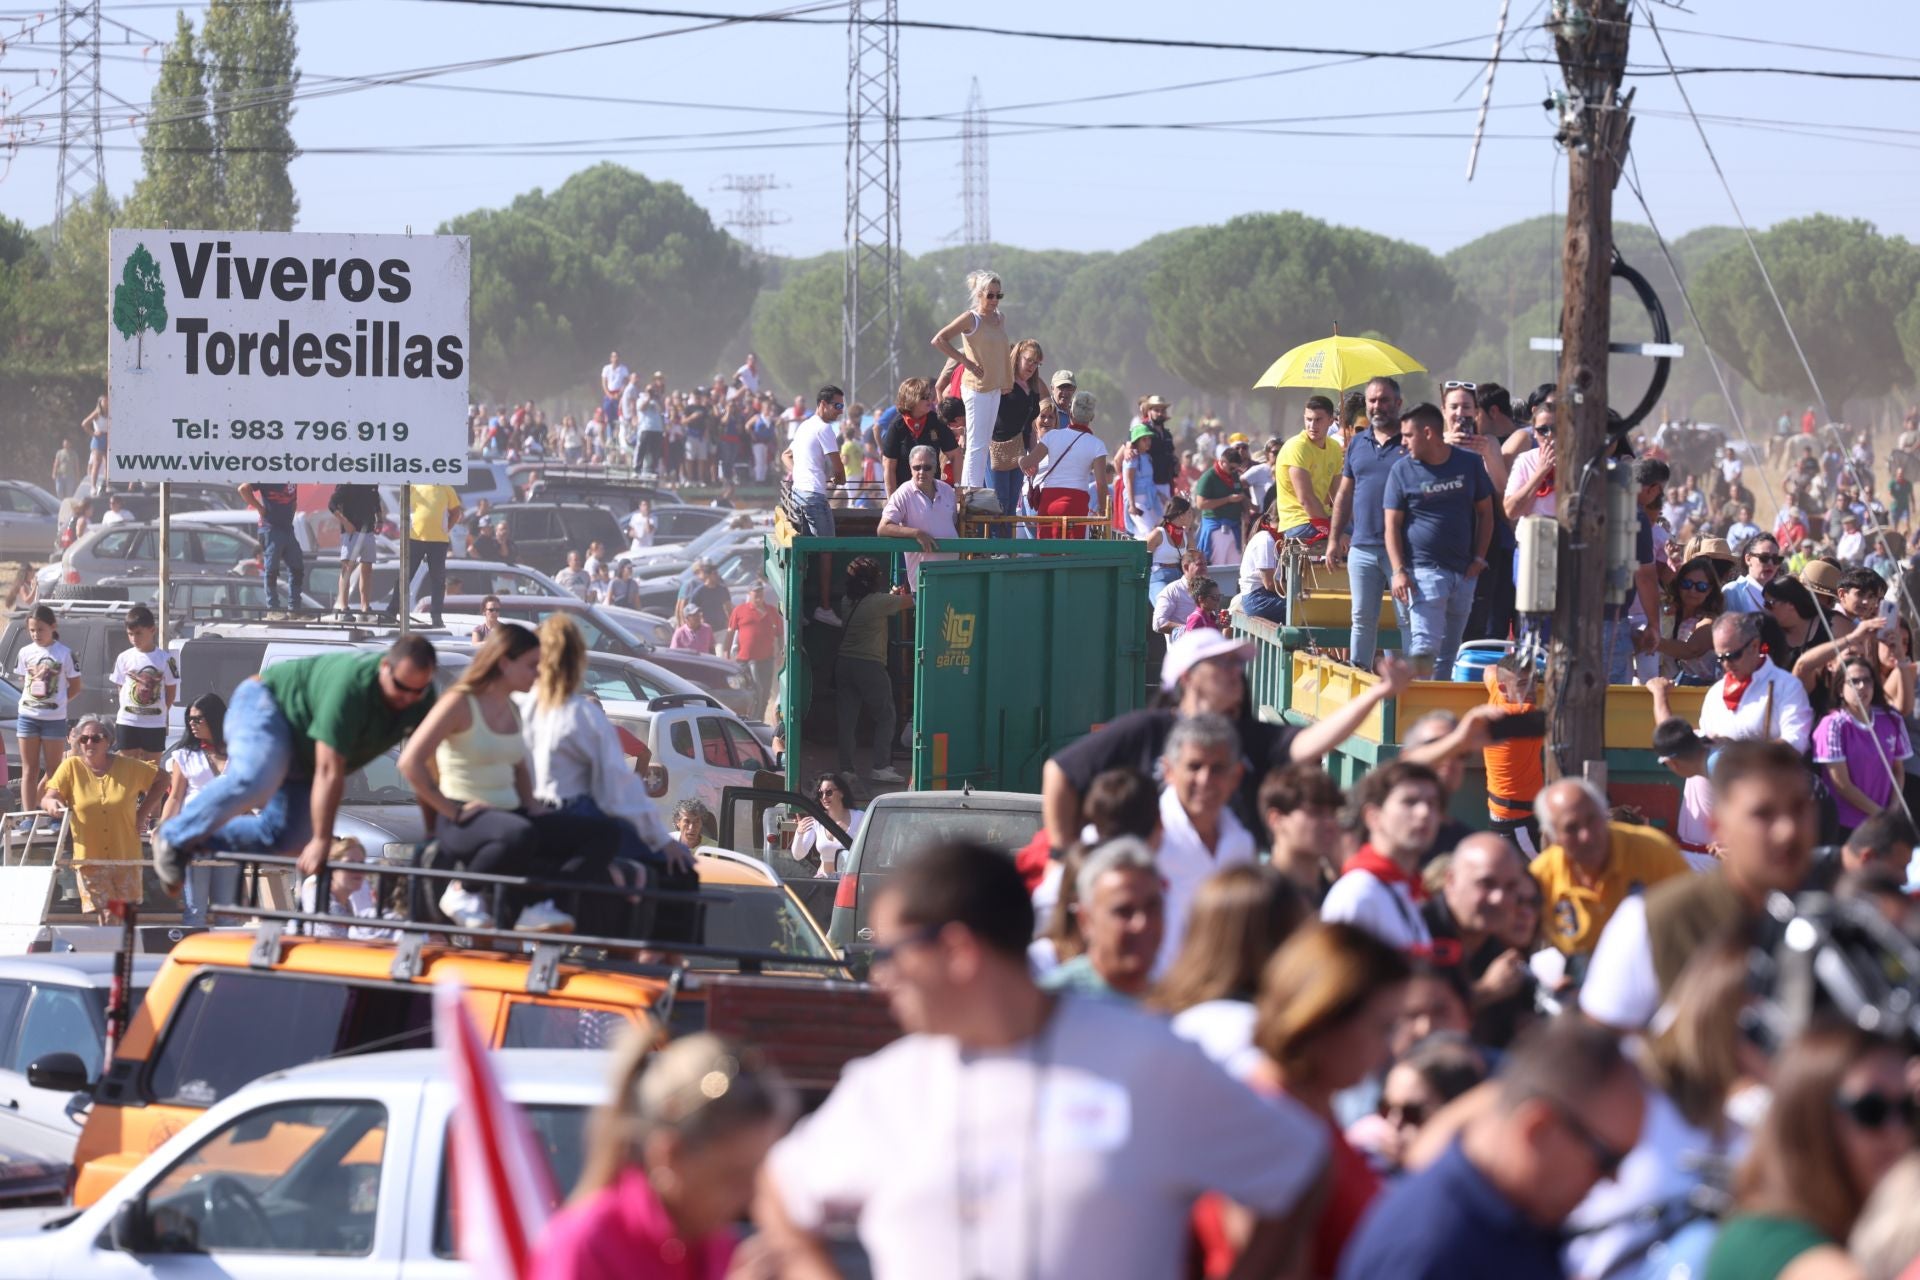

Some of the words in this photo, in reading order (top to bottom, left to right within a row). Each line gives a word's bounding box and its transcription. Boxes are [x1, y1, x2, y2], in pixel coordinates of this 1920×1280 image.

[170, 241, 412, 304] Viveros
[176, 317, 464, 380] Tordesillas
[172, 418, 219, 440] Tel:
[231, 419, 284, 440] 983
[294, 420, 348, 441] 796
[358, 421, 409, 442] 919
[115, 451, 463, 474] www.viverostordesillas.es
